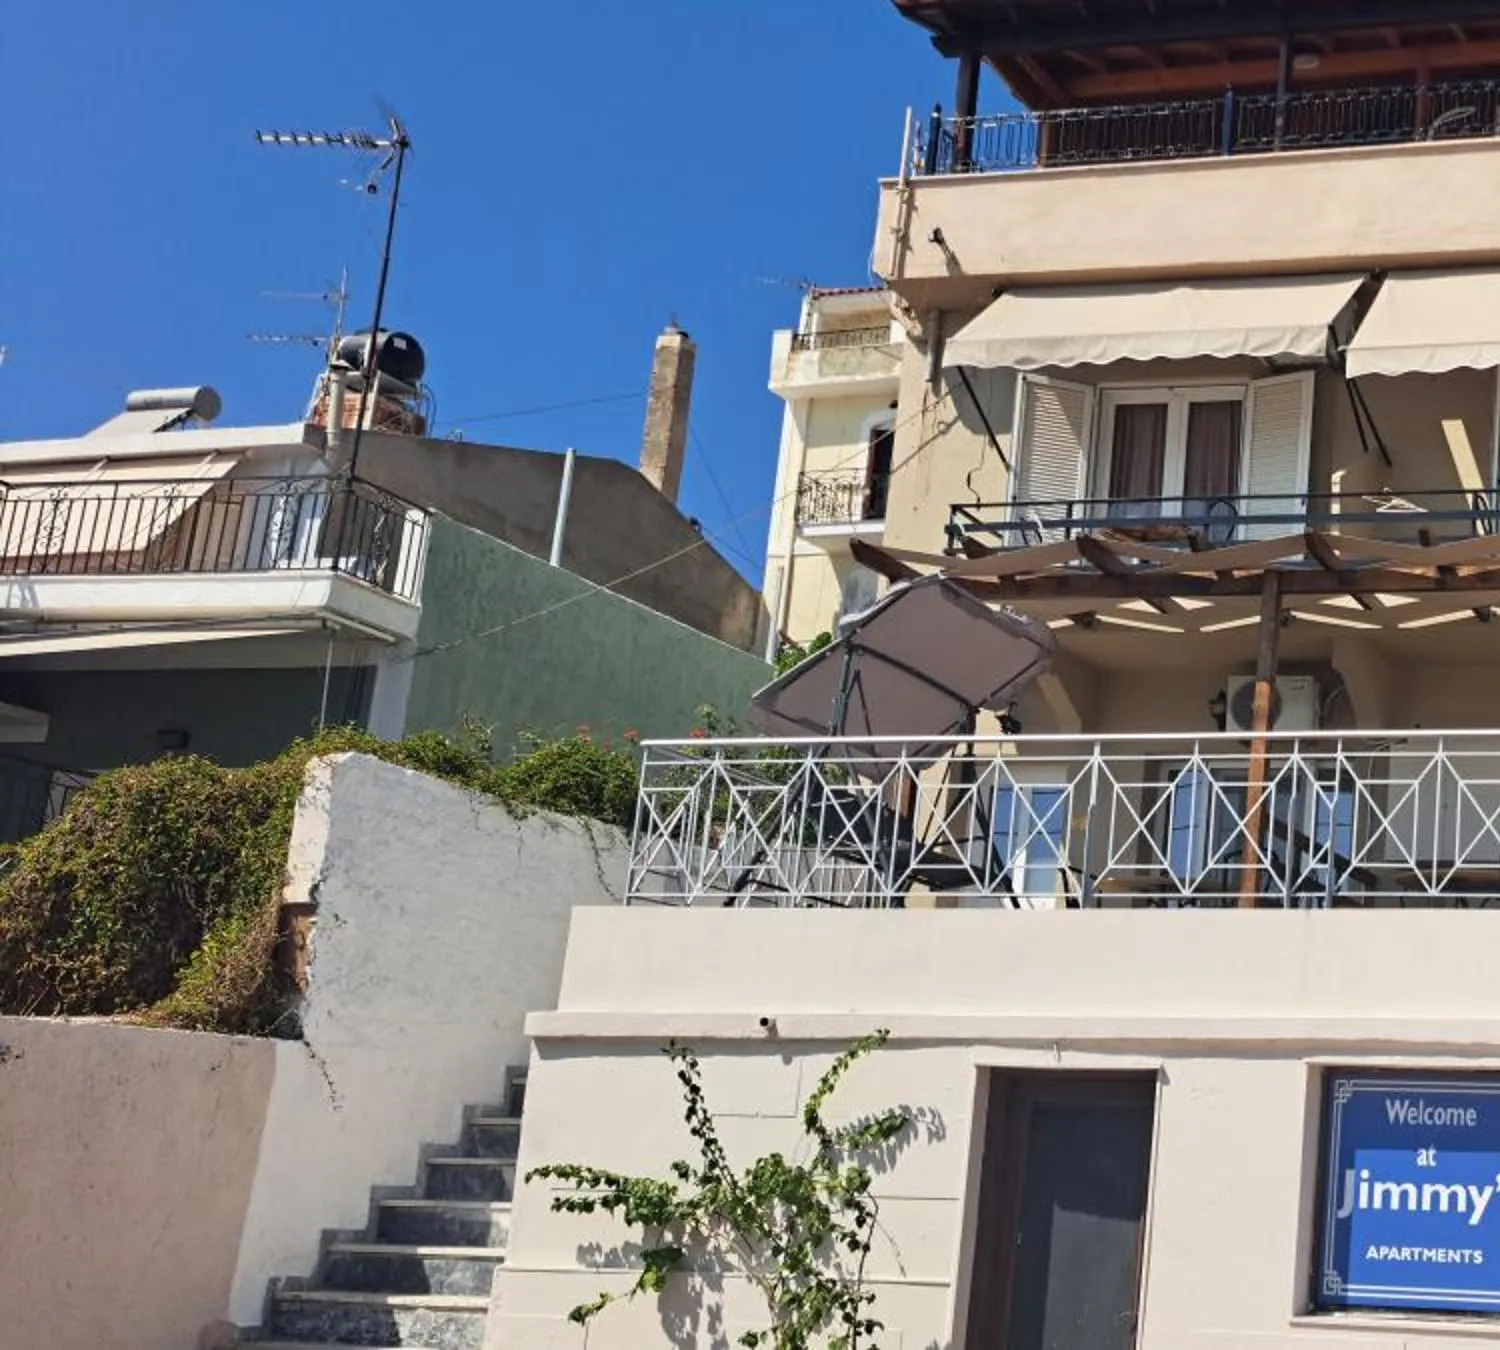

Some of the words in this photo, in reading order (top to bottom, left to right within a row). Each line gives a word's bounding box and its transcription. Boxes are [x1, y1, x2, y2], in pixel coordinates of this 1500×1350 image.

[1385, 1098, 1477, 1126] Welcome
[1416, 1145, 1437, 1166] at
[1365, 1245, 1483, 1264] APARTMENTS
